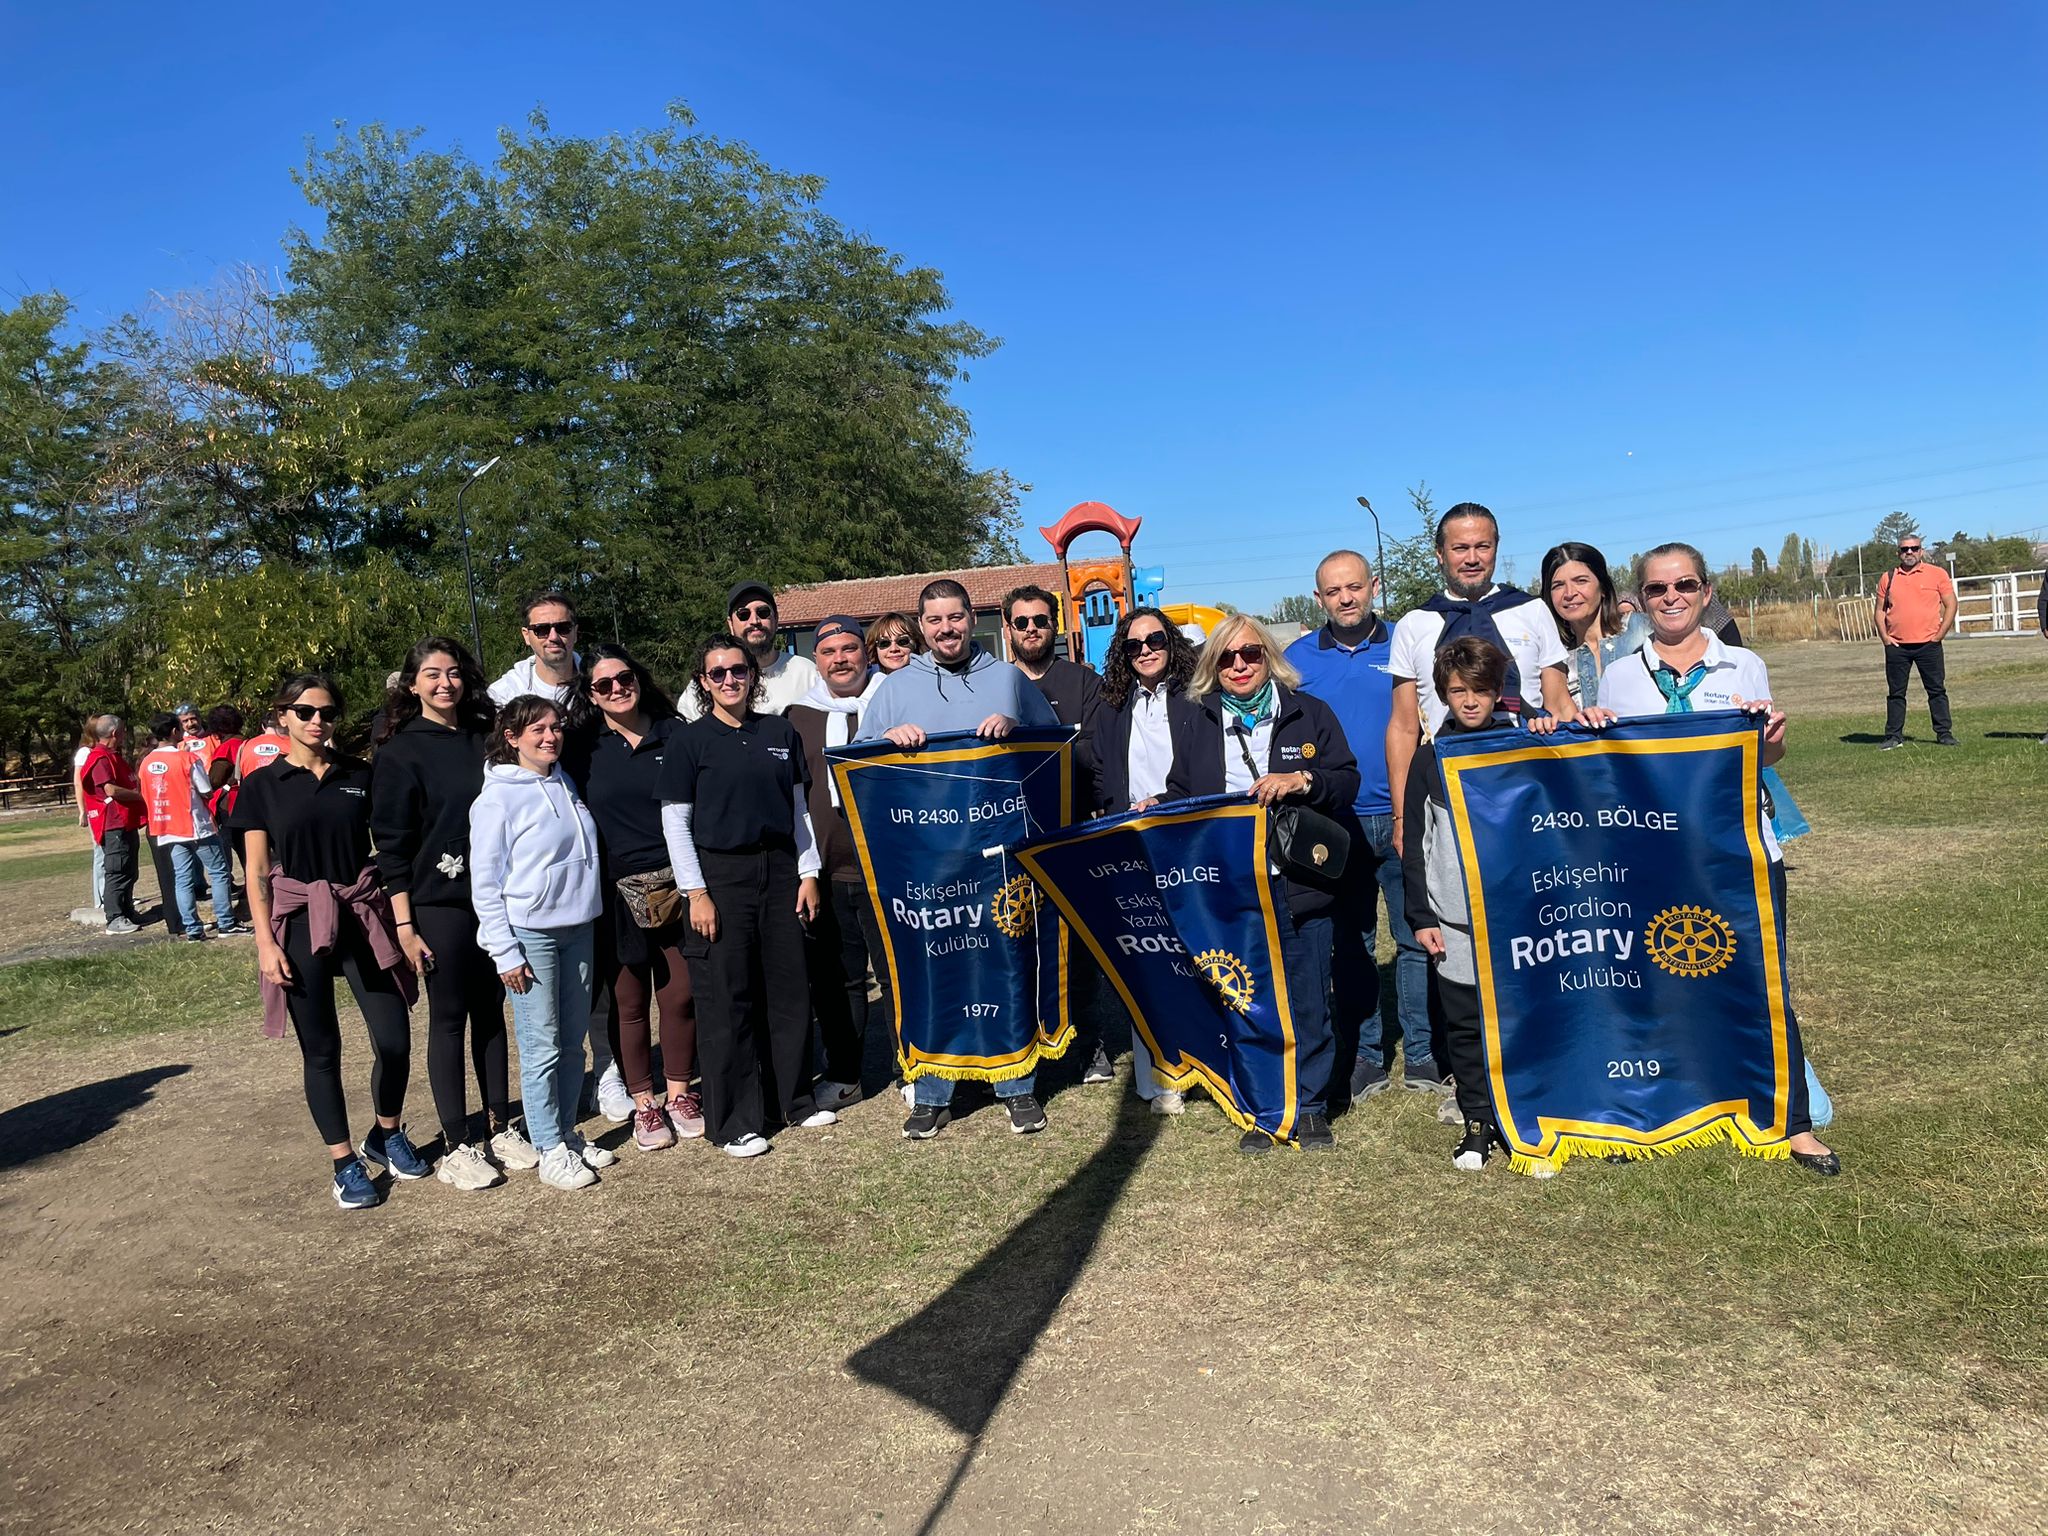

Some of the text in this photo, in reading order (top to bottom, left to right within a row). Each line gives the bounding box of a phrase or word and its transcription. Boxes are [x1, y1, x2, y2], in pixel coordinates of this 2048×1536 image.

[1704, 692, 1730, 701] Rotary
[890, 795, 1027, 824] UR 2430. BÖLGE
[1531, 805, 1679, 832] 2430. BÖLGE
[1088, 863, 1119, 878] UR
[1155, 866, 1220, 889] BÖLGE
[1531, 861, 1629, 893] Eskişehir
[906, 879, 981, 903] Eskişehir
[1115, 893, 1162, 911] Eskiş
[892, 897, 983, 930] Rotary
[1538, 896, 1632, 926] Gordion
[1667, 913, 1706, 923] ROTARY
[925, 933, 990, 958] Kulübü
[1510, 928, 1634, 970] Rotary
[1199, 957, 1229, 968] ROTARY
[1660, 951, 1724, 970] INTERNATIONAL
[1559, 965, 1642, 992] Kulübü
[962, 1003, 1000, 1018] 1977
[1606, 1059, 1661, 1079] 2019
